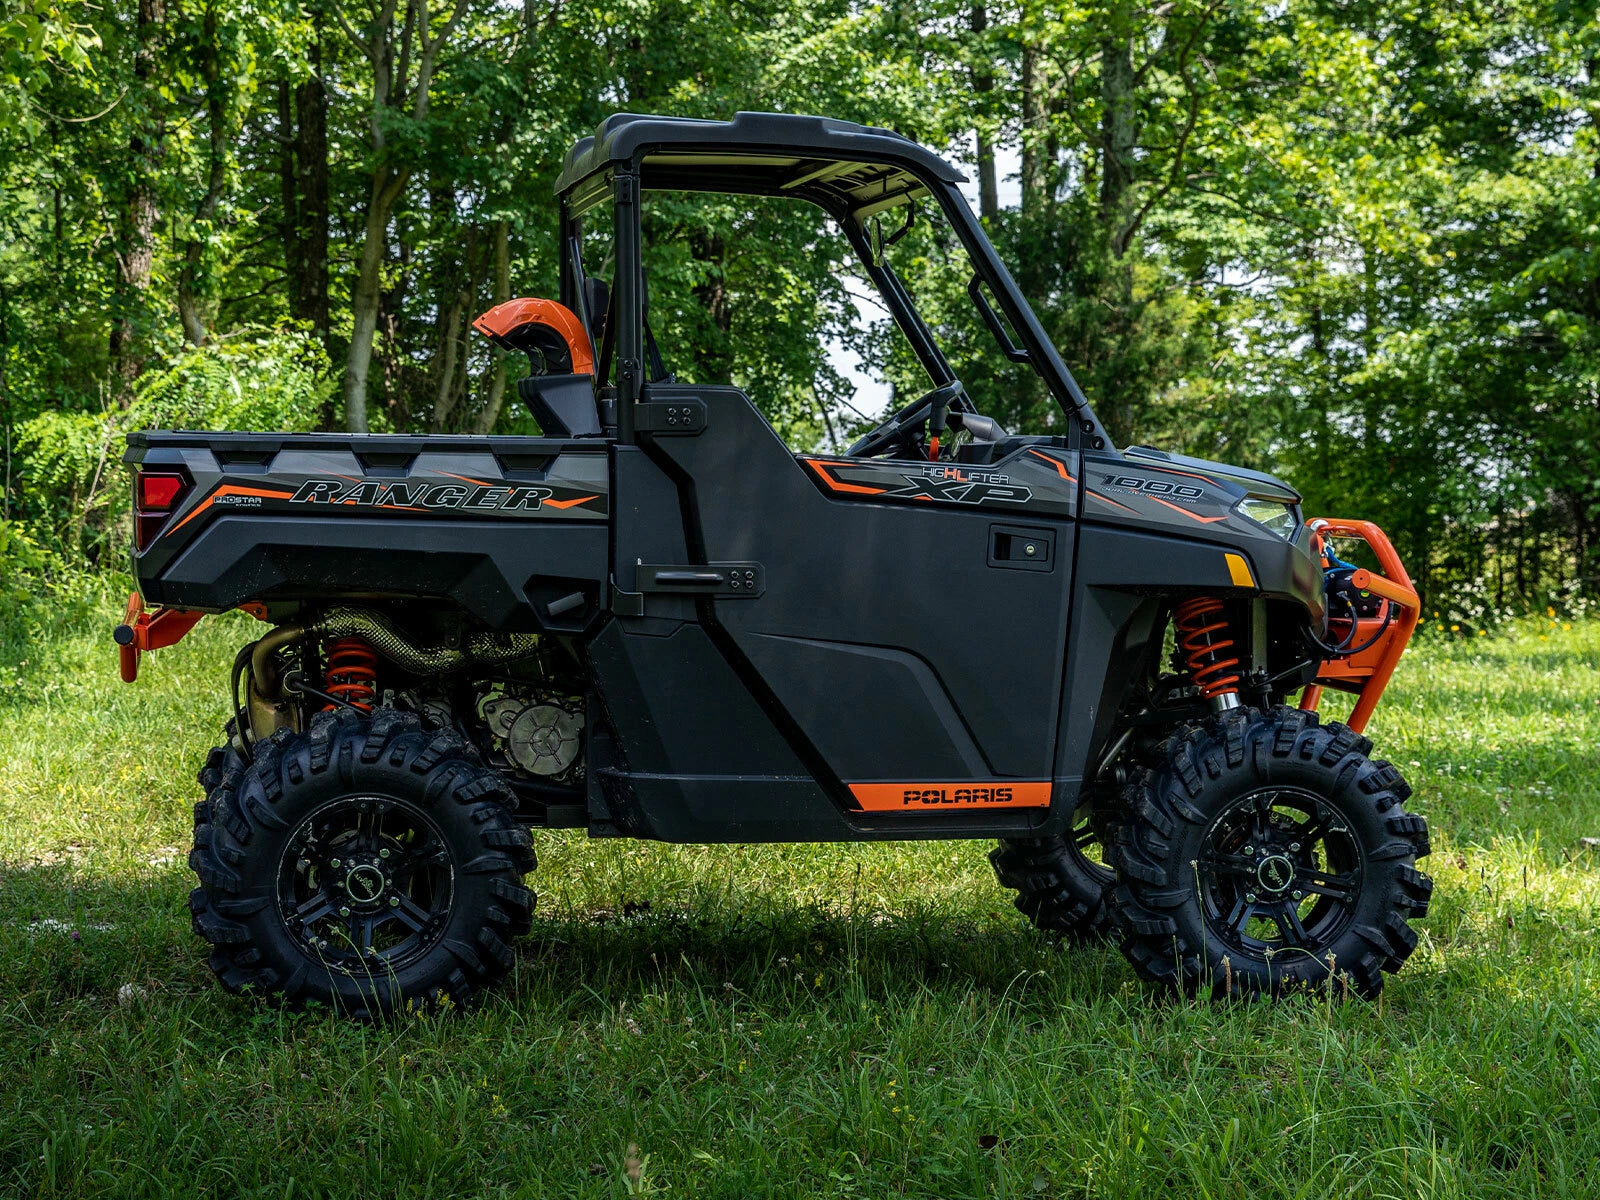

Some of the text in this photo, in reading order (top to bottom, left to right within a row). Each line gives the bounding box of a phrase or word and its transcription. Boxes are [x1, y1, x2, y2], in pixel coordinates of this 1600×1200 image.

[289, 480, 553, 511] RANGER
[884, 475, 1033, 504] XP
[1100, 474, 1204, 498] 1000
[213, 496, 262, 504] PROSTAR
[903, 788, 1013, 805] POLARIS
